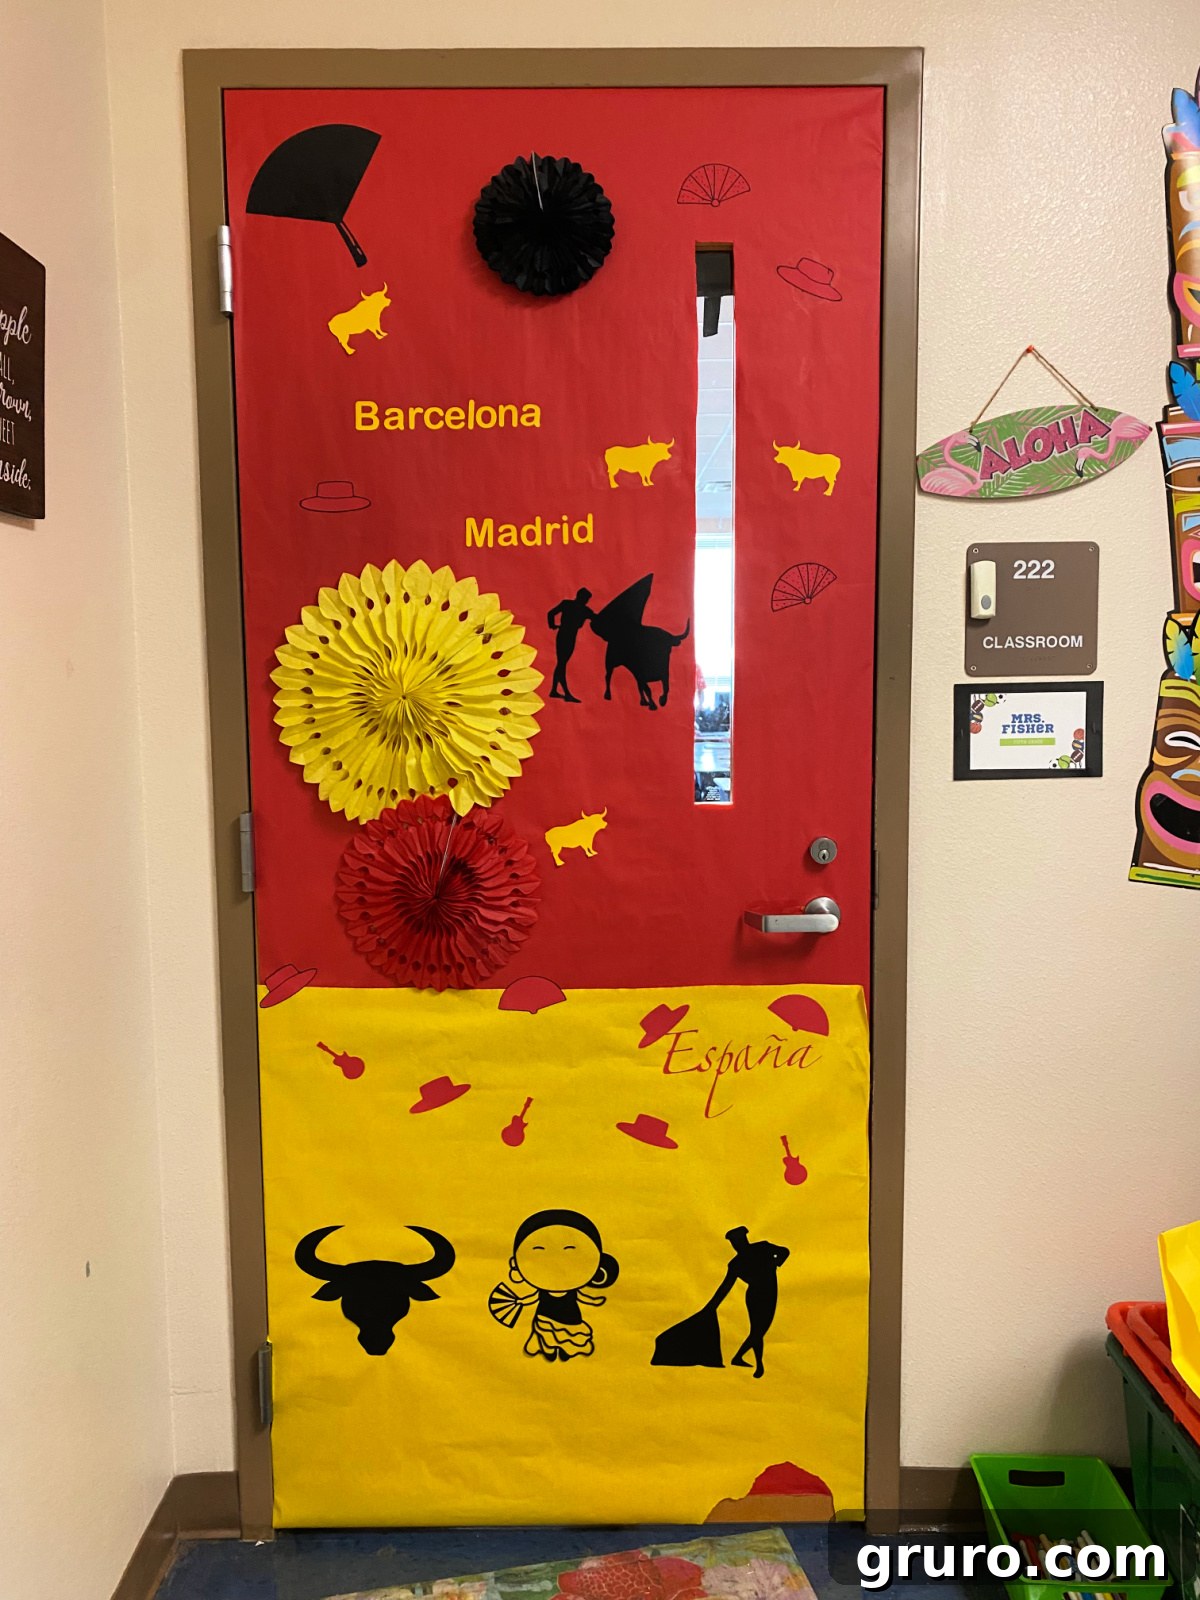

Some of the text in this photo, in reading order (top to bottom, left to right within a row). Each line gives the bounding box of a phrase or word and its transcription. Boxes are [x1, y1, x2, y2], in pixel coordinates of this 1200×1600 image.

[355, 400, 541, 431] Barcelona
[979, 408, 1112, 480] ALOHA
[465, 513, 594, 548] Madrid
[1013, 559, 1055, 580] 222
[982, 635, 1083, 649] CLASSROOM
[1011, 713, 1045, 724] MRS.
[663, 1029, 822, 1119] España
